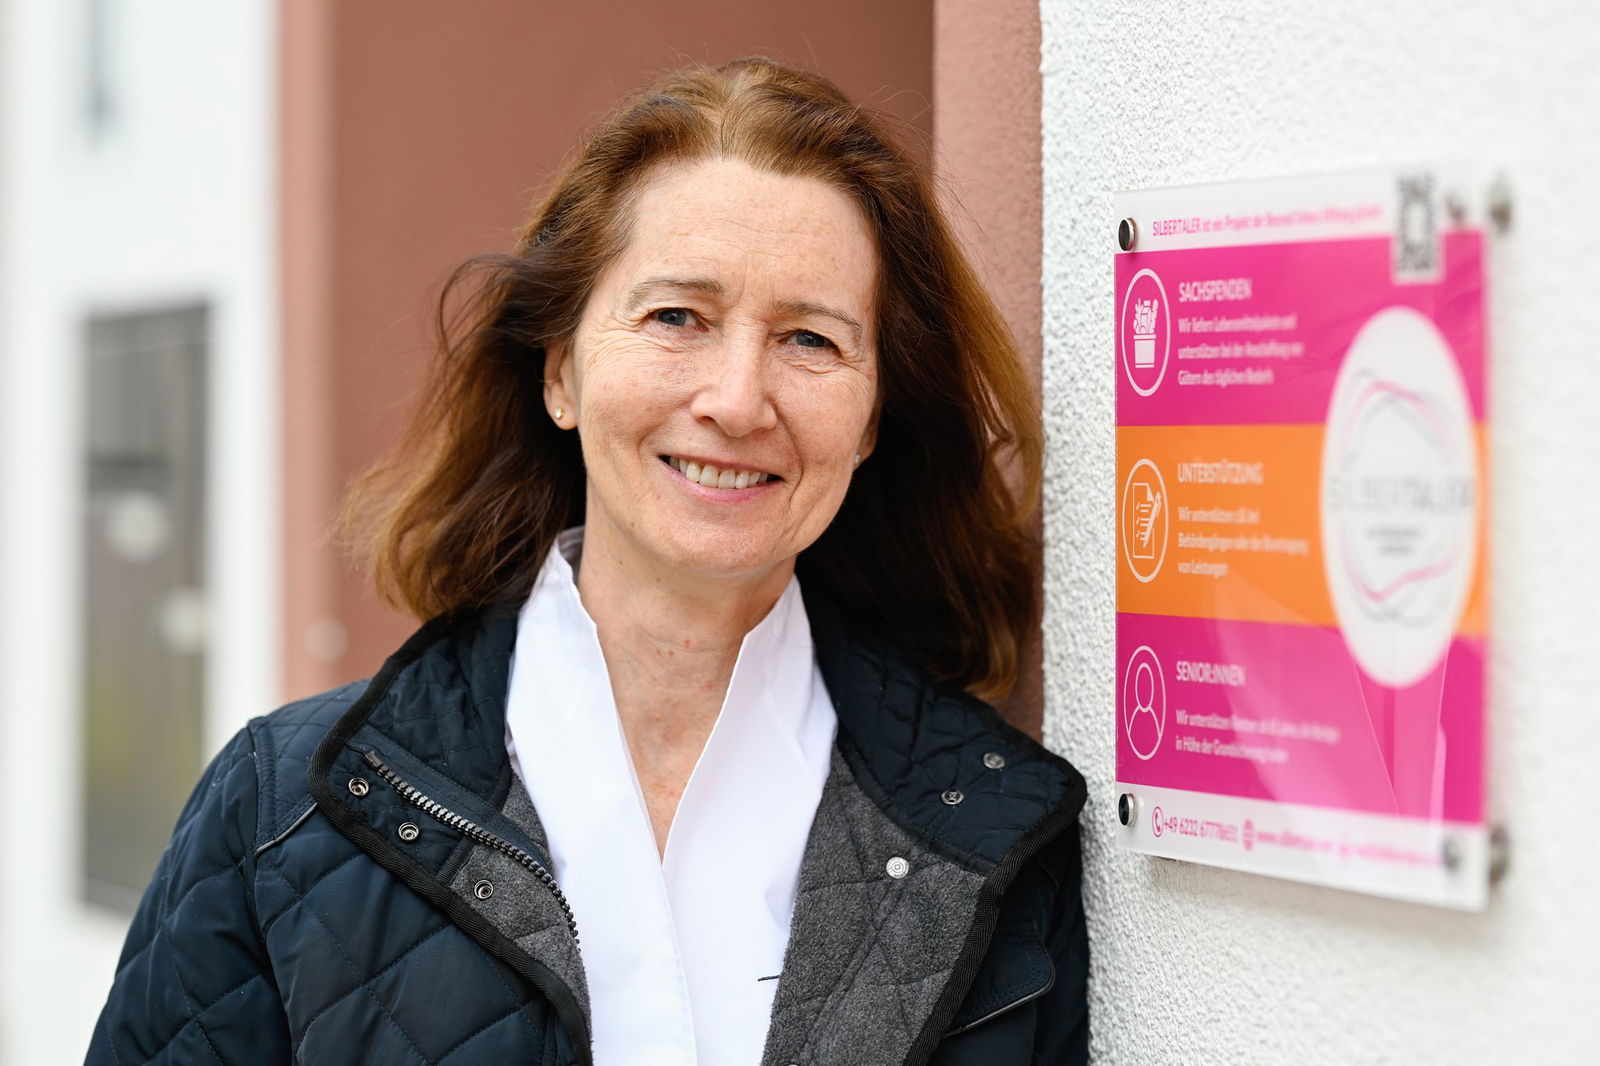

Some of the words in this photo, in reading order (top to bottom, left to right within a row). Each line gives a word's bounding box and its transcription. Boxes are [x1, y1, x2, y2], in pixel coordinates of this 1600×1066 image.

[1153, 218, 1200, 236] SILBERTALER
[1179, 278, 1252, 302] SACHSPENDEN
[1178, 317, 1191, 333] Wir
[1179, 369, 1202, 385] Gütern
[1177, 458, 1264, 485] UNTERSTÜTZUNG
[1178, 506, 1191, 522] Wir
[1178, 563, 1191, 573] von
[1176, 660, 1246, 687] SENIOR:INNEN
[1175, 710, 1189, 725] Wir
[1176, 735, 1183, 750] in
[1183, 736, 1201, 753] Höhe
[1164, 817, 1178, 833] +49
[1180, 818, 1198, 836] 6232
